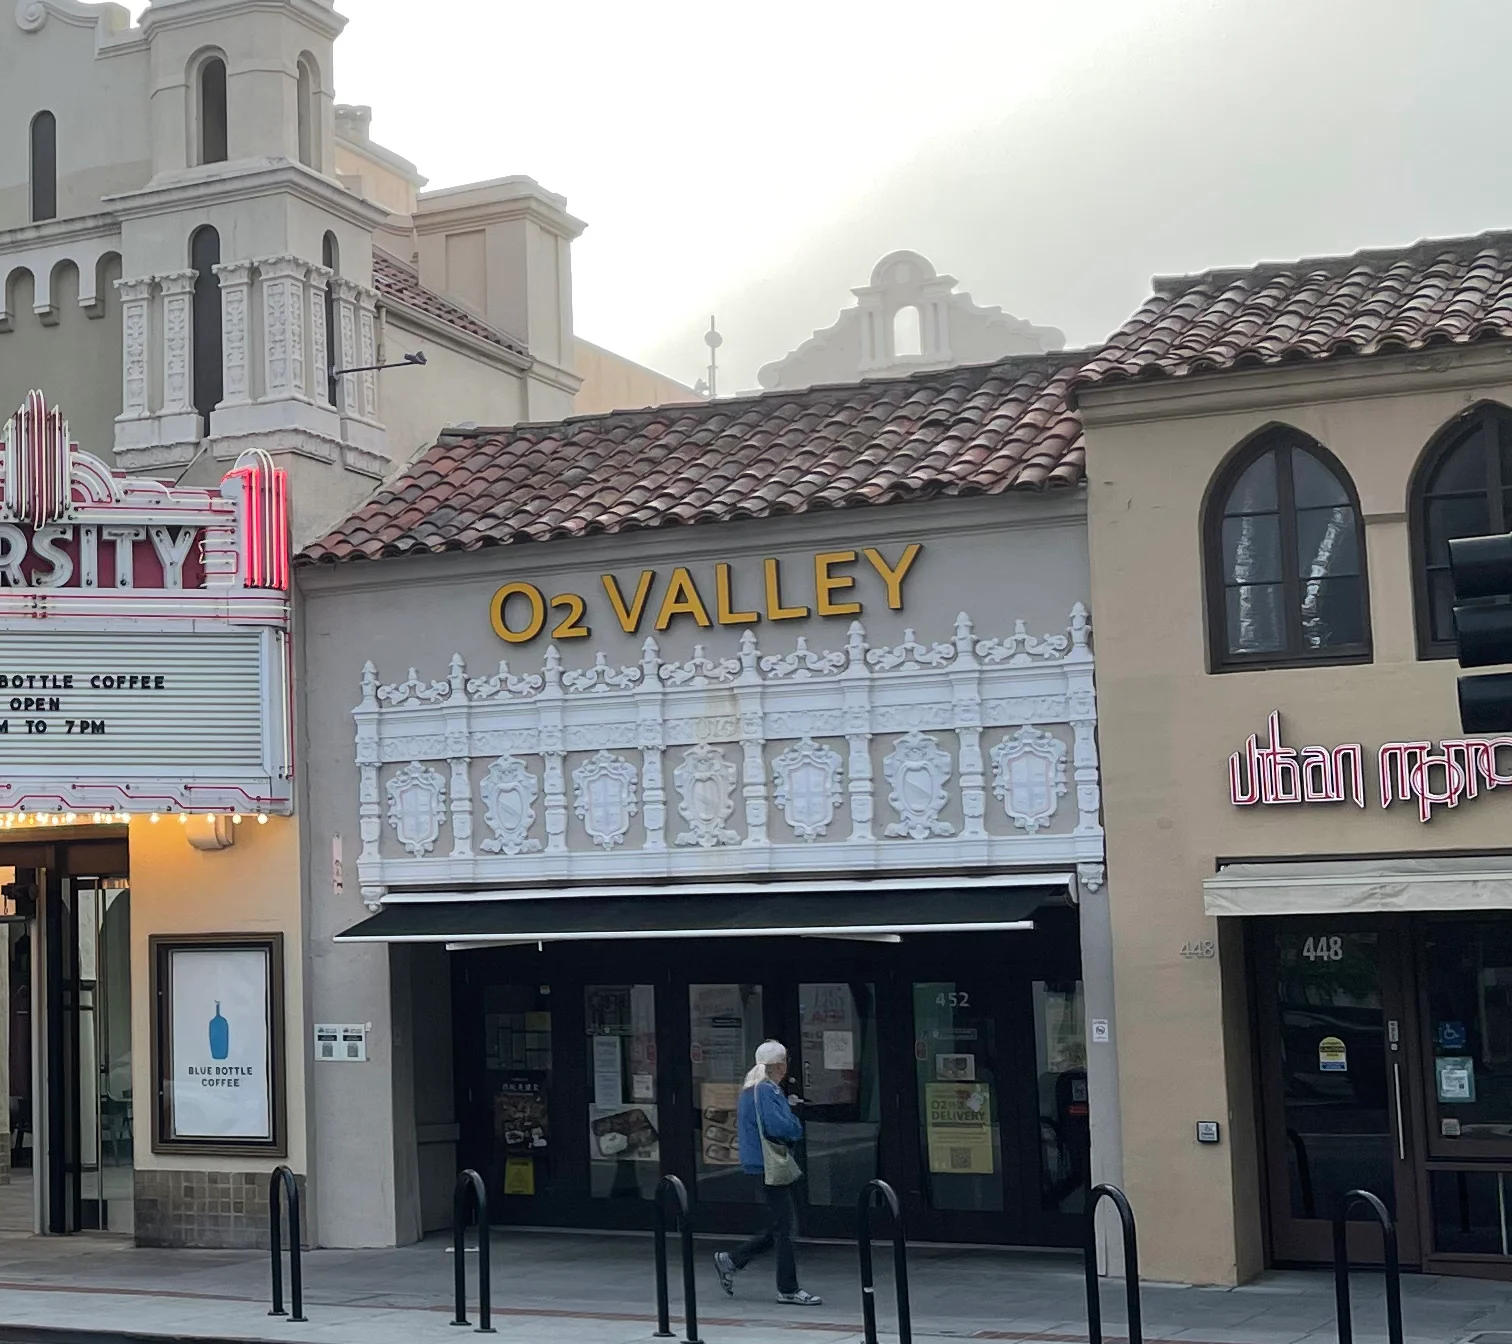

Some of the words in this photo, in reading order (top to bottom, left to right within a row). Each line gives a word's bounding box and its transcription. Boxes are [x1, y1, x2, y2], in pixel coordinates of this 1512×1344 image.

[600, 543, 924, 634] VALLEY
[90, 674, 166, 690] COFFEE
[9, 697, 61, 712] OPEN
[25, 719, 47, 734] TO
[65, 719, 106, 735] 7PM
[1180, 940, 1215, 959] 448
[1302, 936, 1344, 961] 448
[935, 991, 971, 1007] 452
[188, 1066, 212, 1075] BLUE
[215, 1066, 253, 1076] BOTTLE
[201, 1078, 240, 1088] COFFEE
[931, 1110, 985, 1121] DELIVERY
